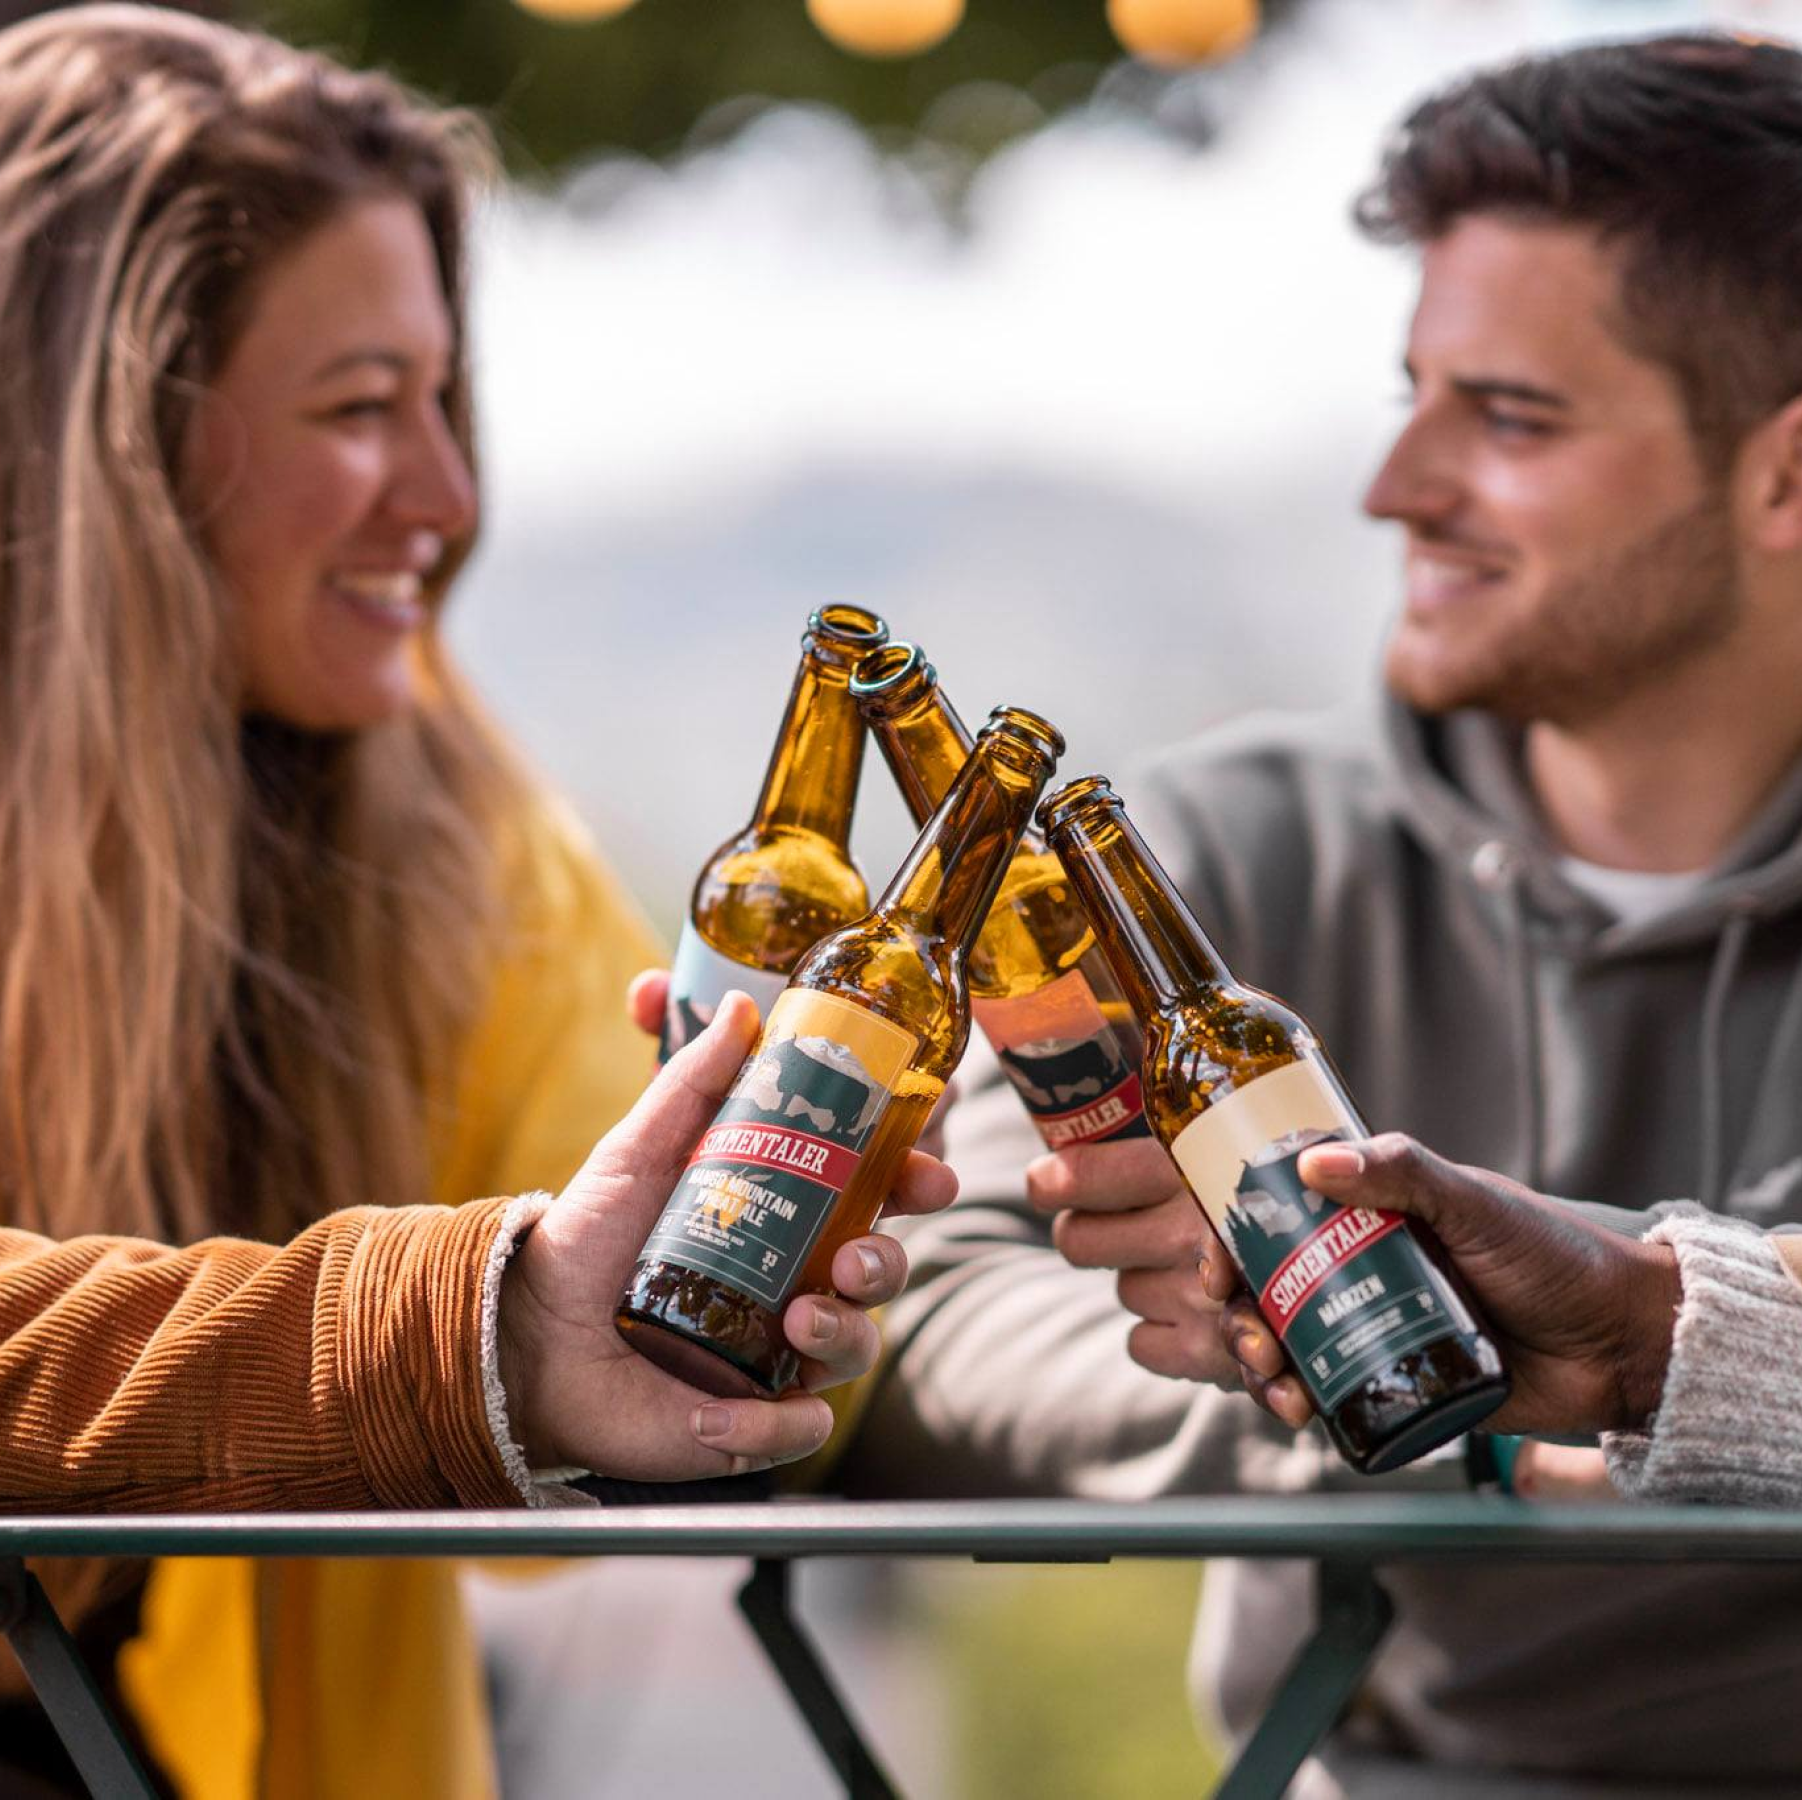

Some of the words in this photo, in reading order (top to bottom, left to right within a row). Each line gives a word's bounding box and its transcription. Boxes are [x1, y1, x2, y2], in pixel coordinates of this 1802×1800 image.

[700, 1128, 829, 1175] SIMMENTALER
[687, 1168, 729, 1189] MANGO
[727, 1177, 798, 1221] MOUNTAIN
[694, 1187, 740, 1213] WHEAT
[739, 1201, 769, 1228] ALE
[1317, 1274, 1386, 1328] MÄRZEN
